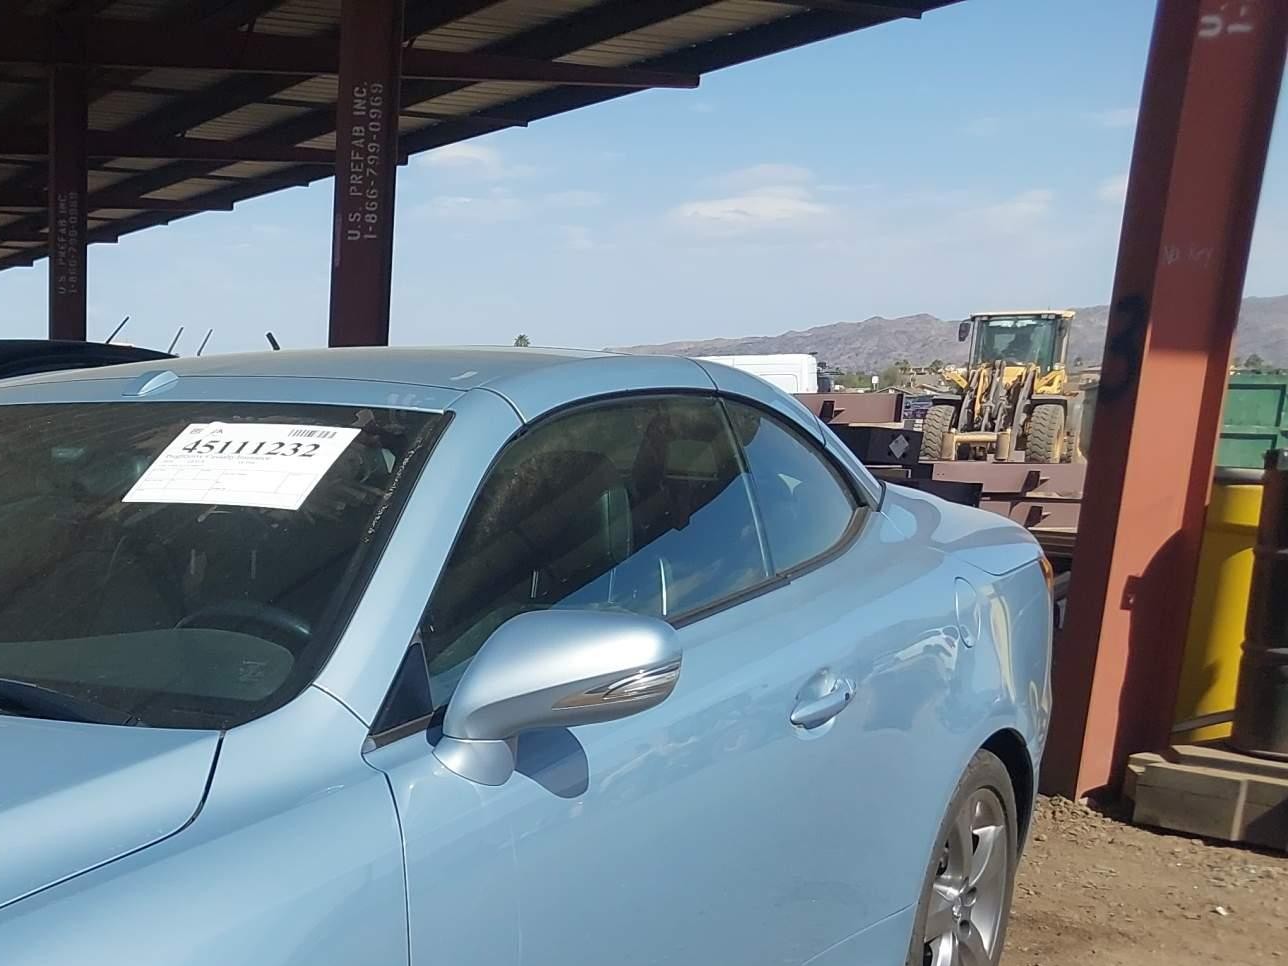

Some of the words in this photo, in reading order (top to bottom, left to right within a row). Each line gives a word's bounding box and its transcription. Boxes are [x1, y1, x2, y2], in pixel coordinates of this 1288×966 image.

[353, 81, 368, 116] INC.
[350, 126, 366, 196] PREFAB
[364, 83, 383, 239] 1-866-799-0969
[347, 208, 362, 241] U.S.
[182, 439, 321, 458] 45111232
